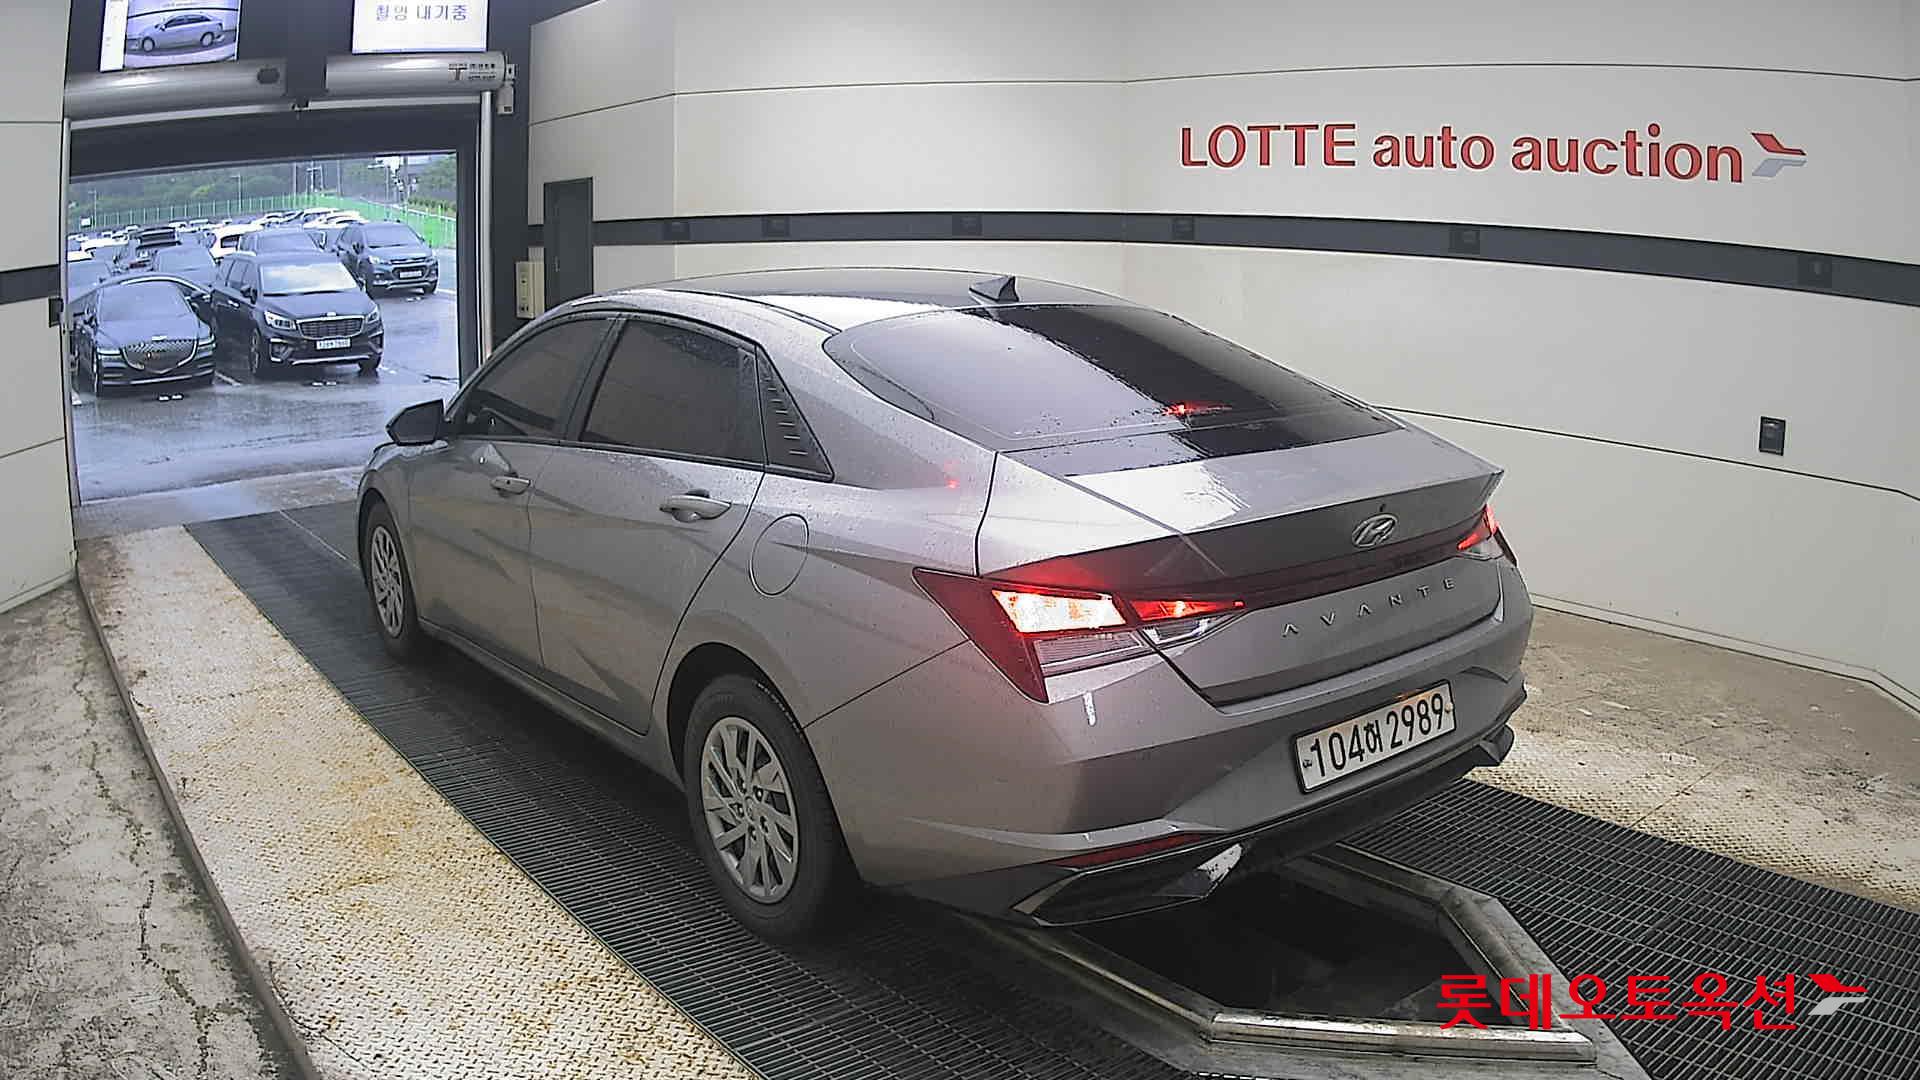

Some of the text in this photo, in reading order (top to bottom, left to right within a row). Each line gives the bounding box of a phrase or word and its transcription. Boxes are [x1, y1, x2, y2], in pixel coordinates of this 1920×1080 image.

[1180, 122, 1744, 183] LOTTE auto auction
[1281, 577, 1456, 637] AVANTE
